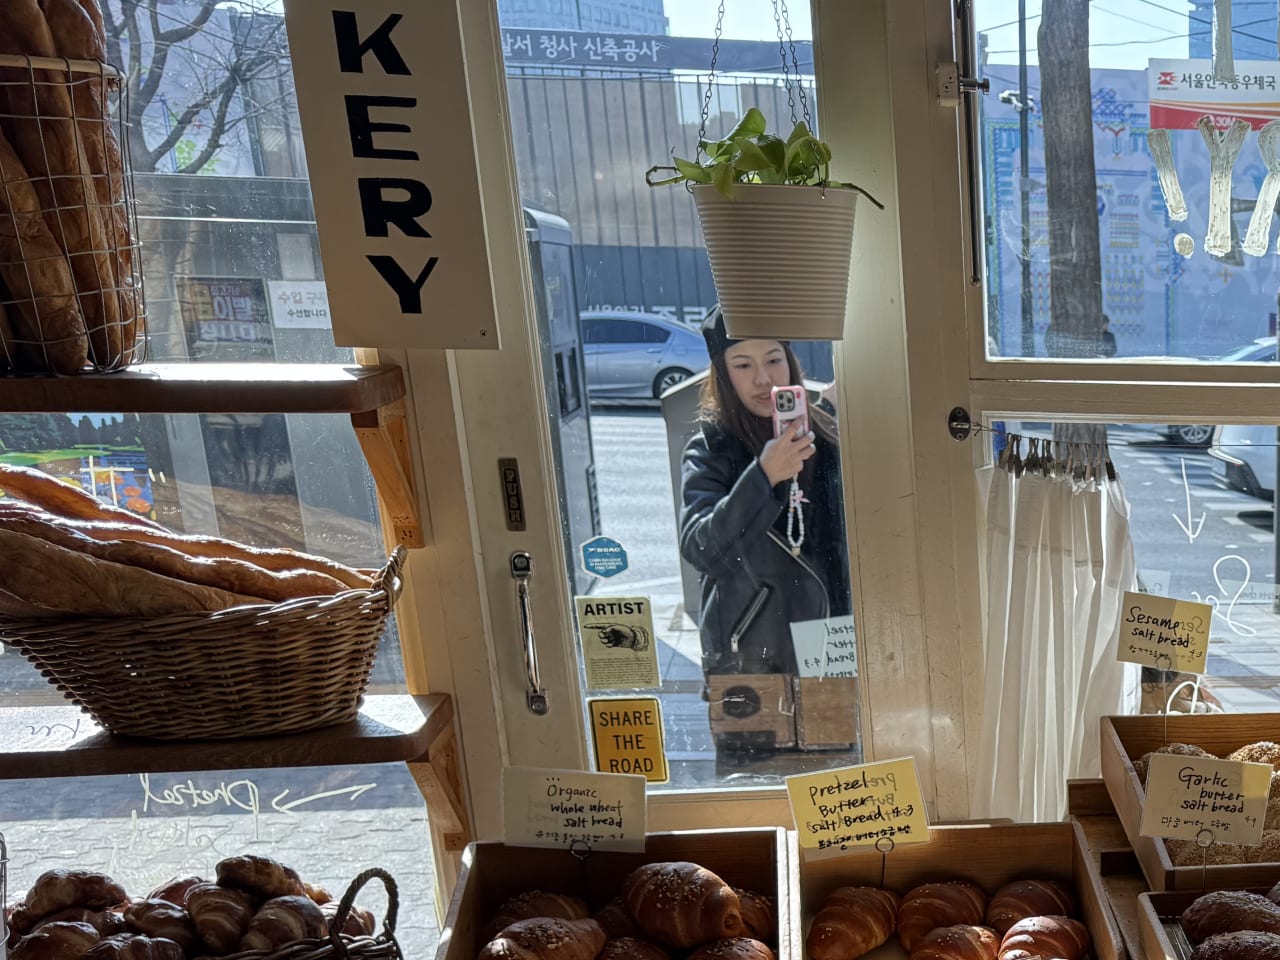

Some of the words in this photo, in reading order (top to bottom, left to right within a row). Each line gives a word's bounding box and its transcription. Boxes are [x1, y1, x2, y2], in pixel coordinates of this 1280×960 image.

[540, 36, 576, 59] 청사
[584, 40, 659, 63] 신축공사
[330, 10, 439, 315] KERY
[502, 467, 522, 523] PUSH
[584, 602, 644, 616] ARTIST
[1126, 606, 1179, 636] Sesame
[1131, 627, 1155, 640] salt
[1157, 633, 1190, 648] bread
[599, 710, 654, 727] SHARE
[613, 734, 646, 750] THE
[609, 758, 654, 774] ROAD
[1178, 766, 1228, 789] Garlic
[547, 784, 598, 801] Organic
[1200, 788, 1244, 800] butter
[551, 802, 584, 814] whole
[589, 800, 624, 816] wheat
[818, 796, 873, 818] Butter
[1181, 800, 1208, 812] salt
[1211, 801, 1244, 813] bread
[563, 817, 588, 828] salt
[592, 816, 622, 828] bread
[843, 805, 885, 827] Bread
